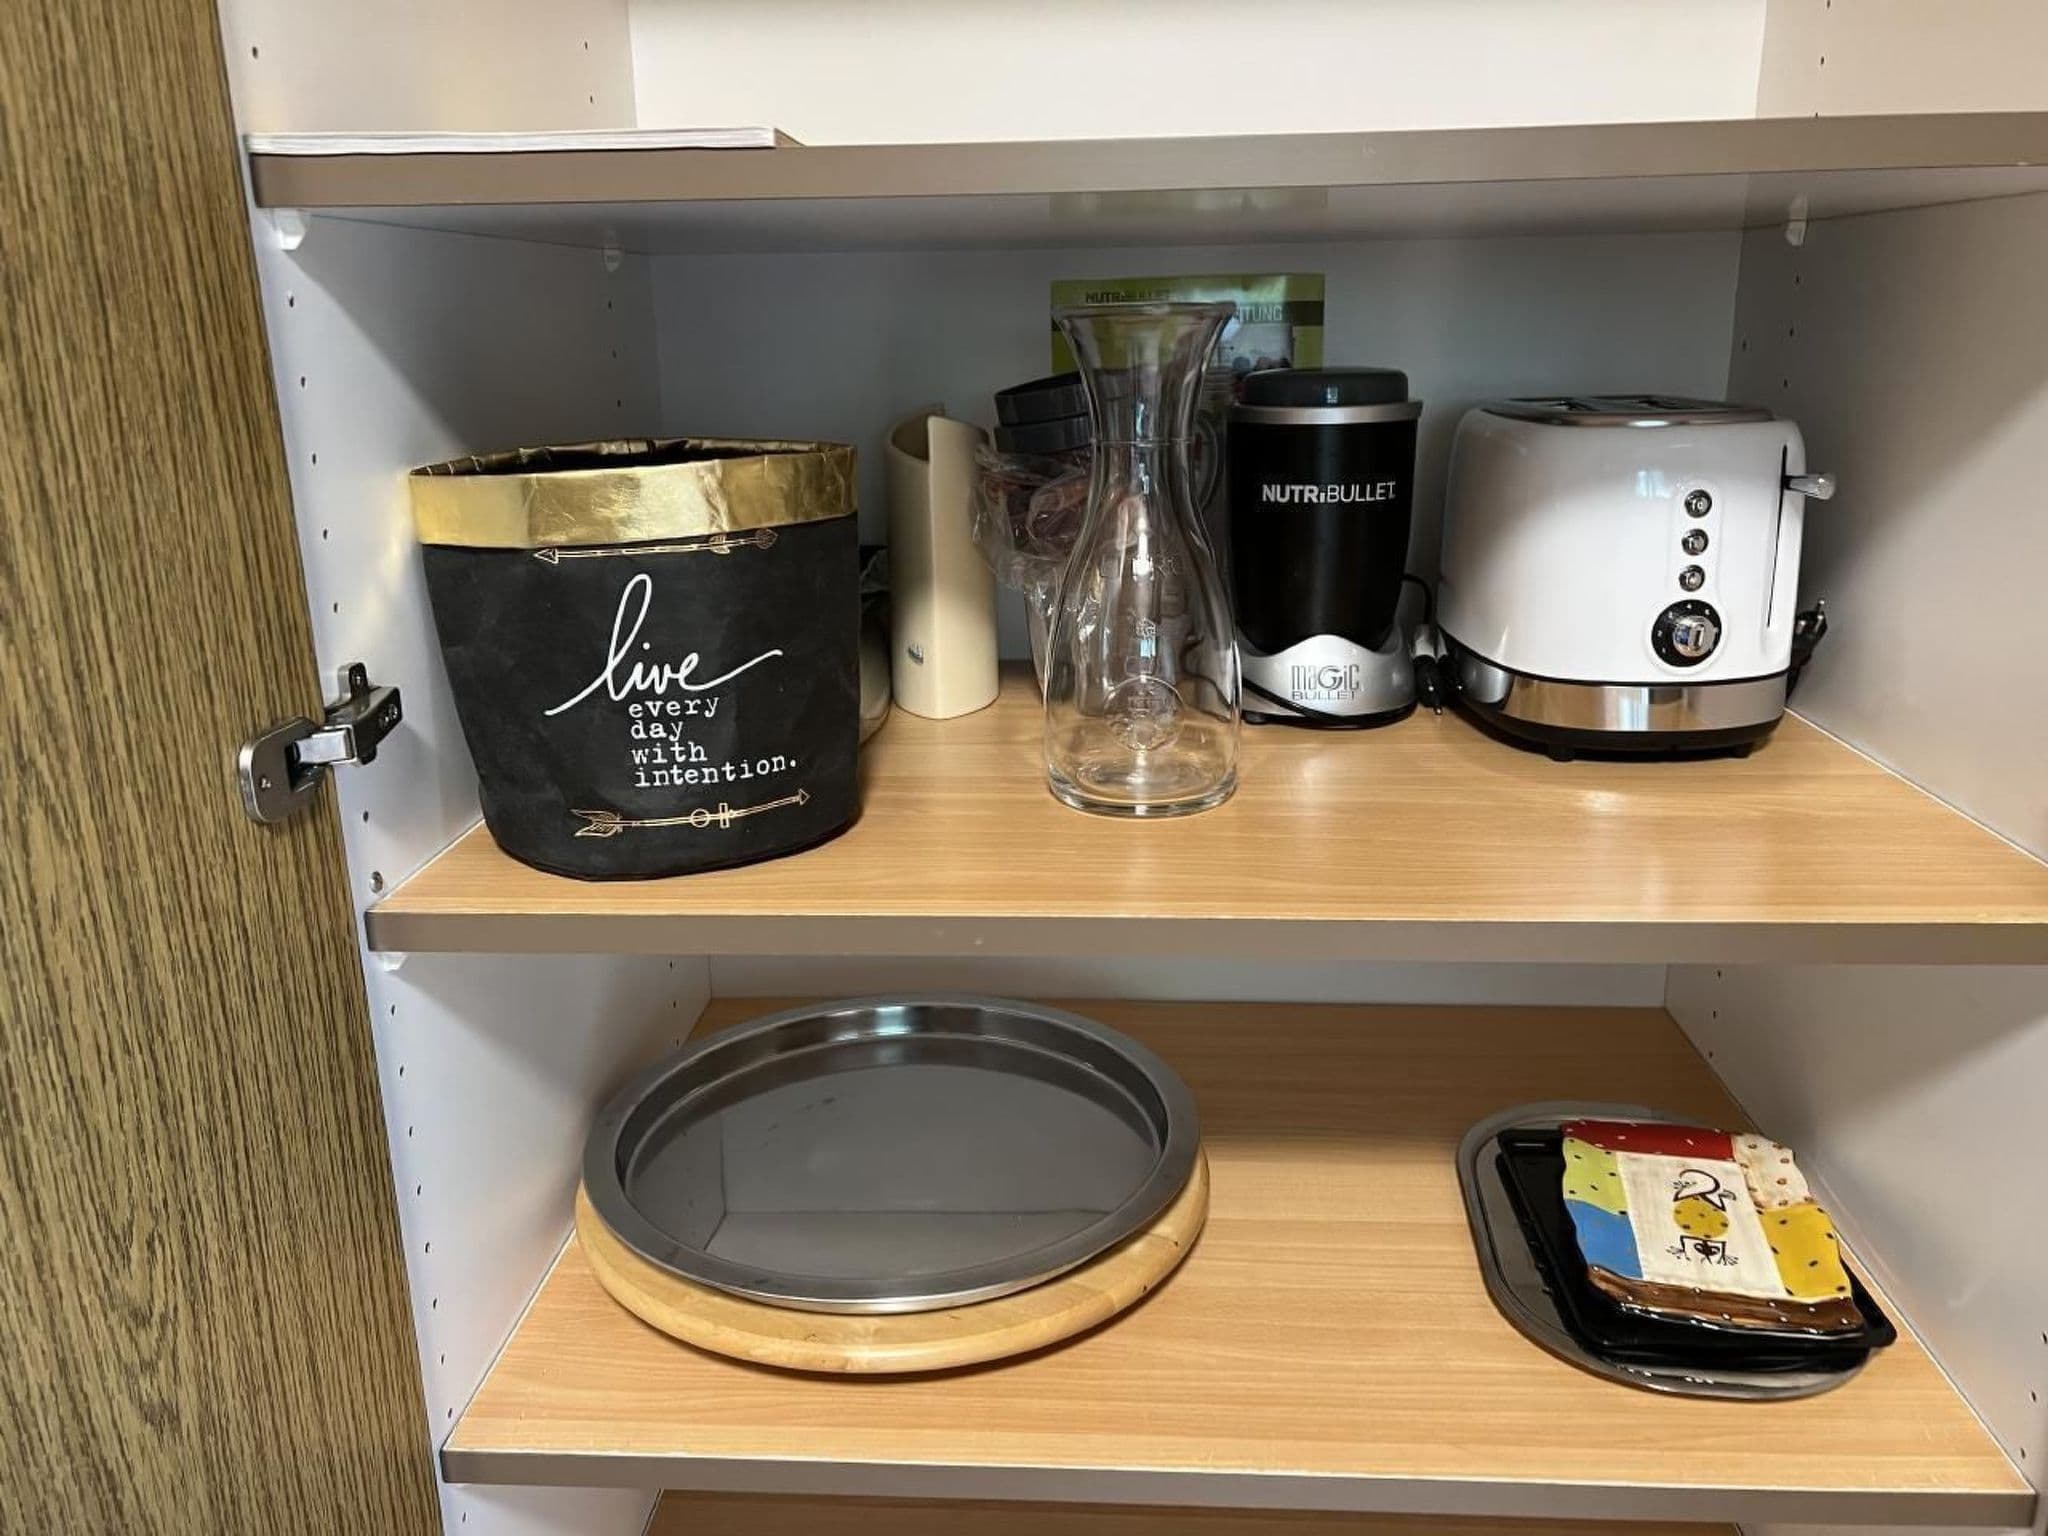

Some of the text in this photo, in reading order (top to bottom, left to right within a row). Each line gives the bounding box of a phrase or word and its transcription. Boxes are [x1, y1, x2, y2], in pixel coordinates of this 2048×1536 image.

[544, 573, 783, 717] live
[1291, 690, 1355, 700] BULLET
[628, 697, 719, 718] every
[630, 719, 684, 742] day
[631, 741, 708, 765] with
[634, 754, 797, 788] intention.
